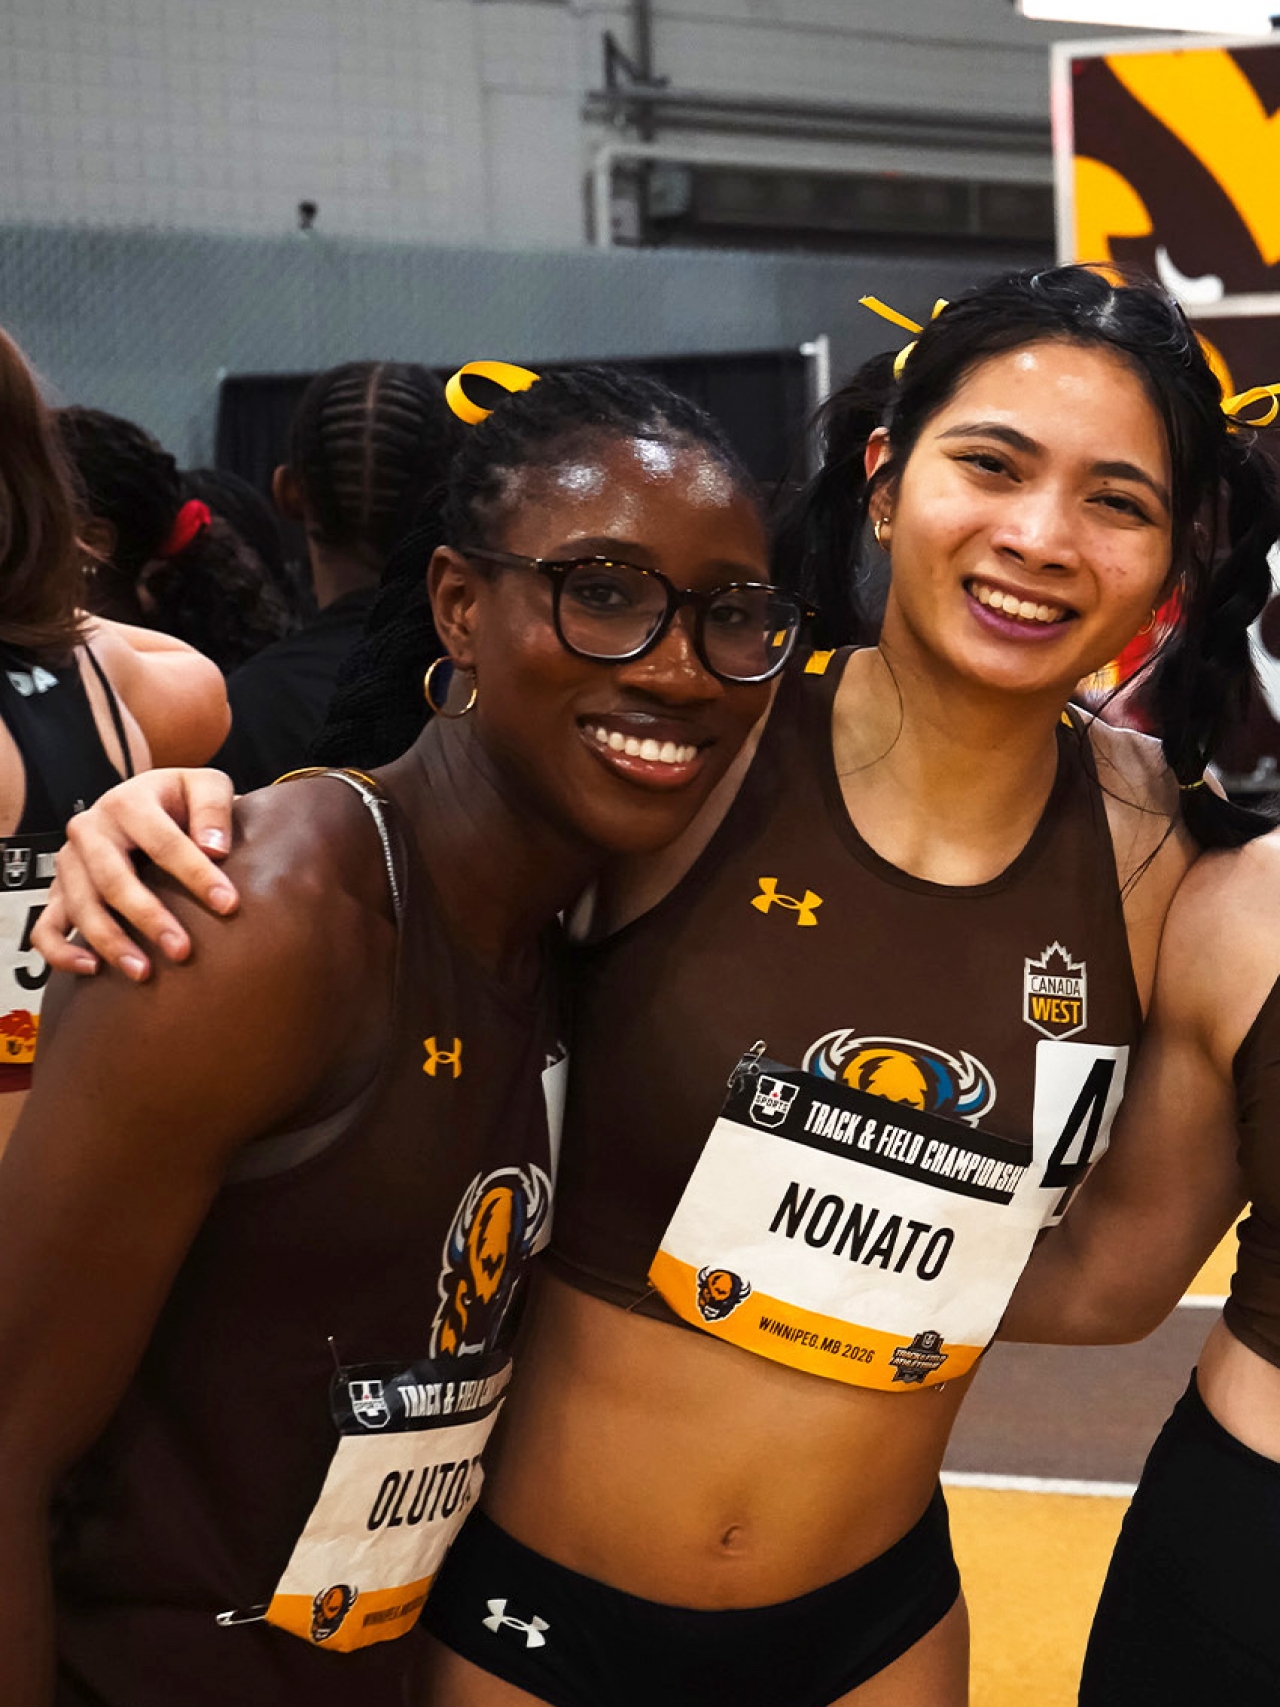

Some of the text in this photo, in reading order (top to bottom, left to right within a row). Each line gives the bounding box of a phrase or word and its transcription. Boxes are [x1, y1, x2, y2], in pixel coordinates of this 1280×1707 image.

[1031, 976, 1082, 996] CANADA
[1032, 998, 1081, 1024] WEST
[804, 1100, 1026, 1194] TRACK & FIELD CHAMPIONSH
[1039, 1058, 1116, 1217] 4
[769, 1181, 955, 1281] NONATO
[841, 1343, 876, 1364] 2026
[398, 1383, 442, 1418] TRACK
[443, 1382, 456, 1415] &
